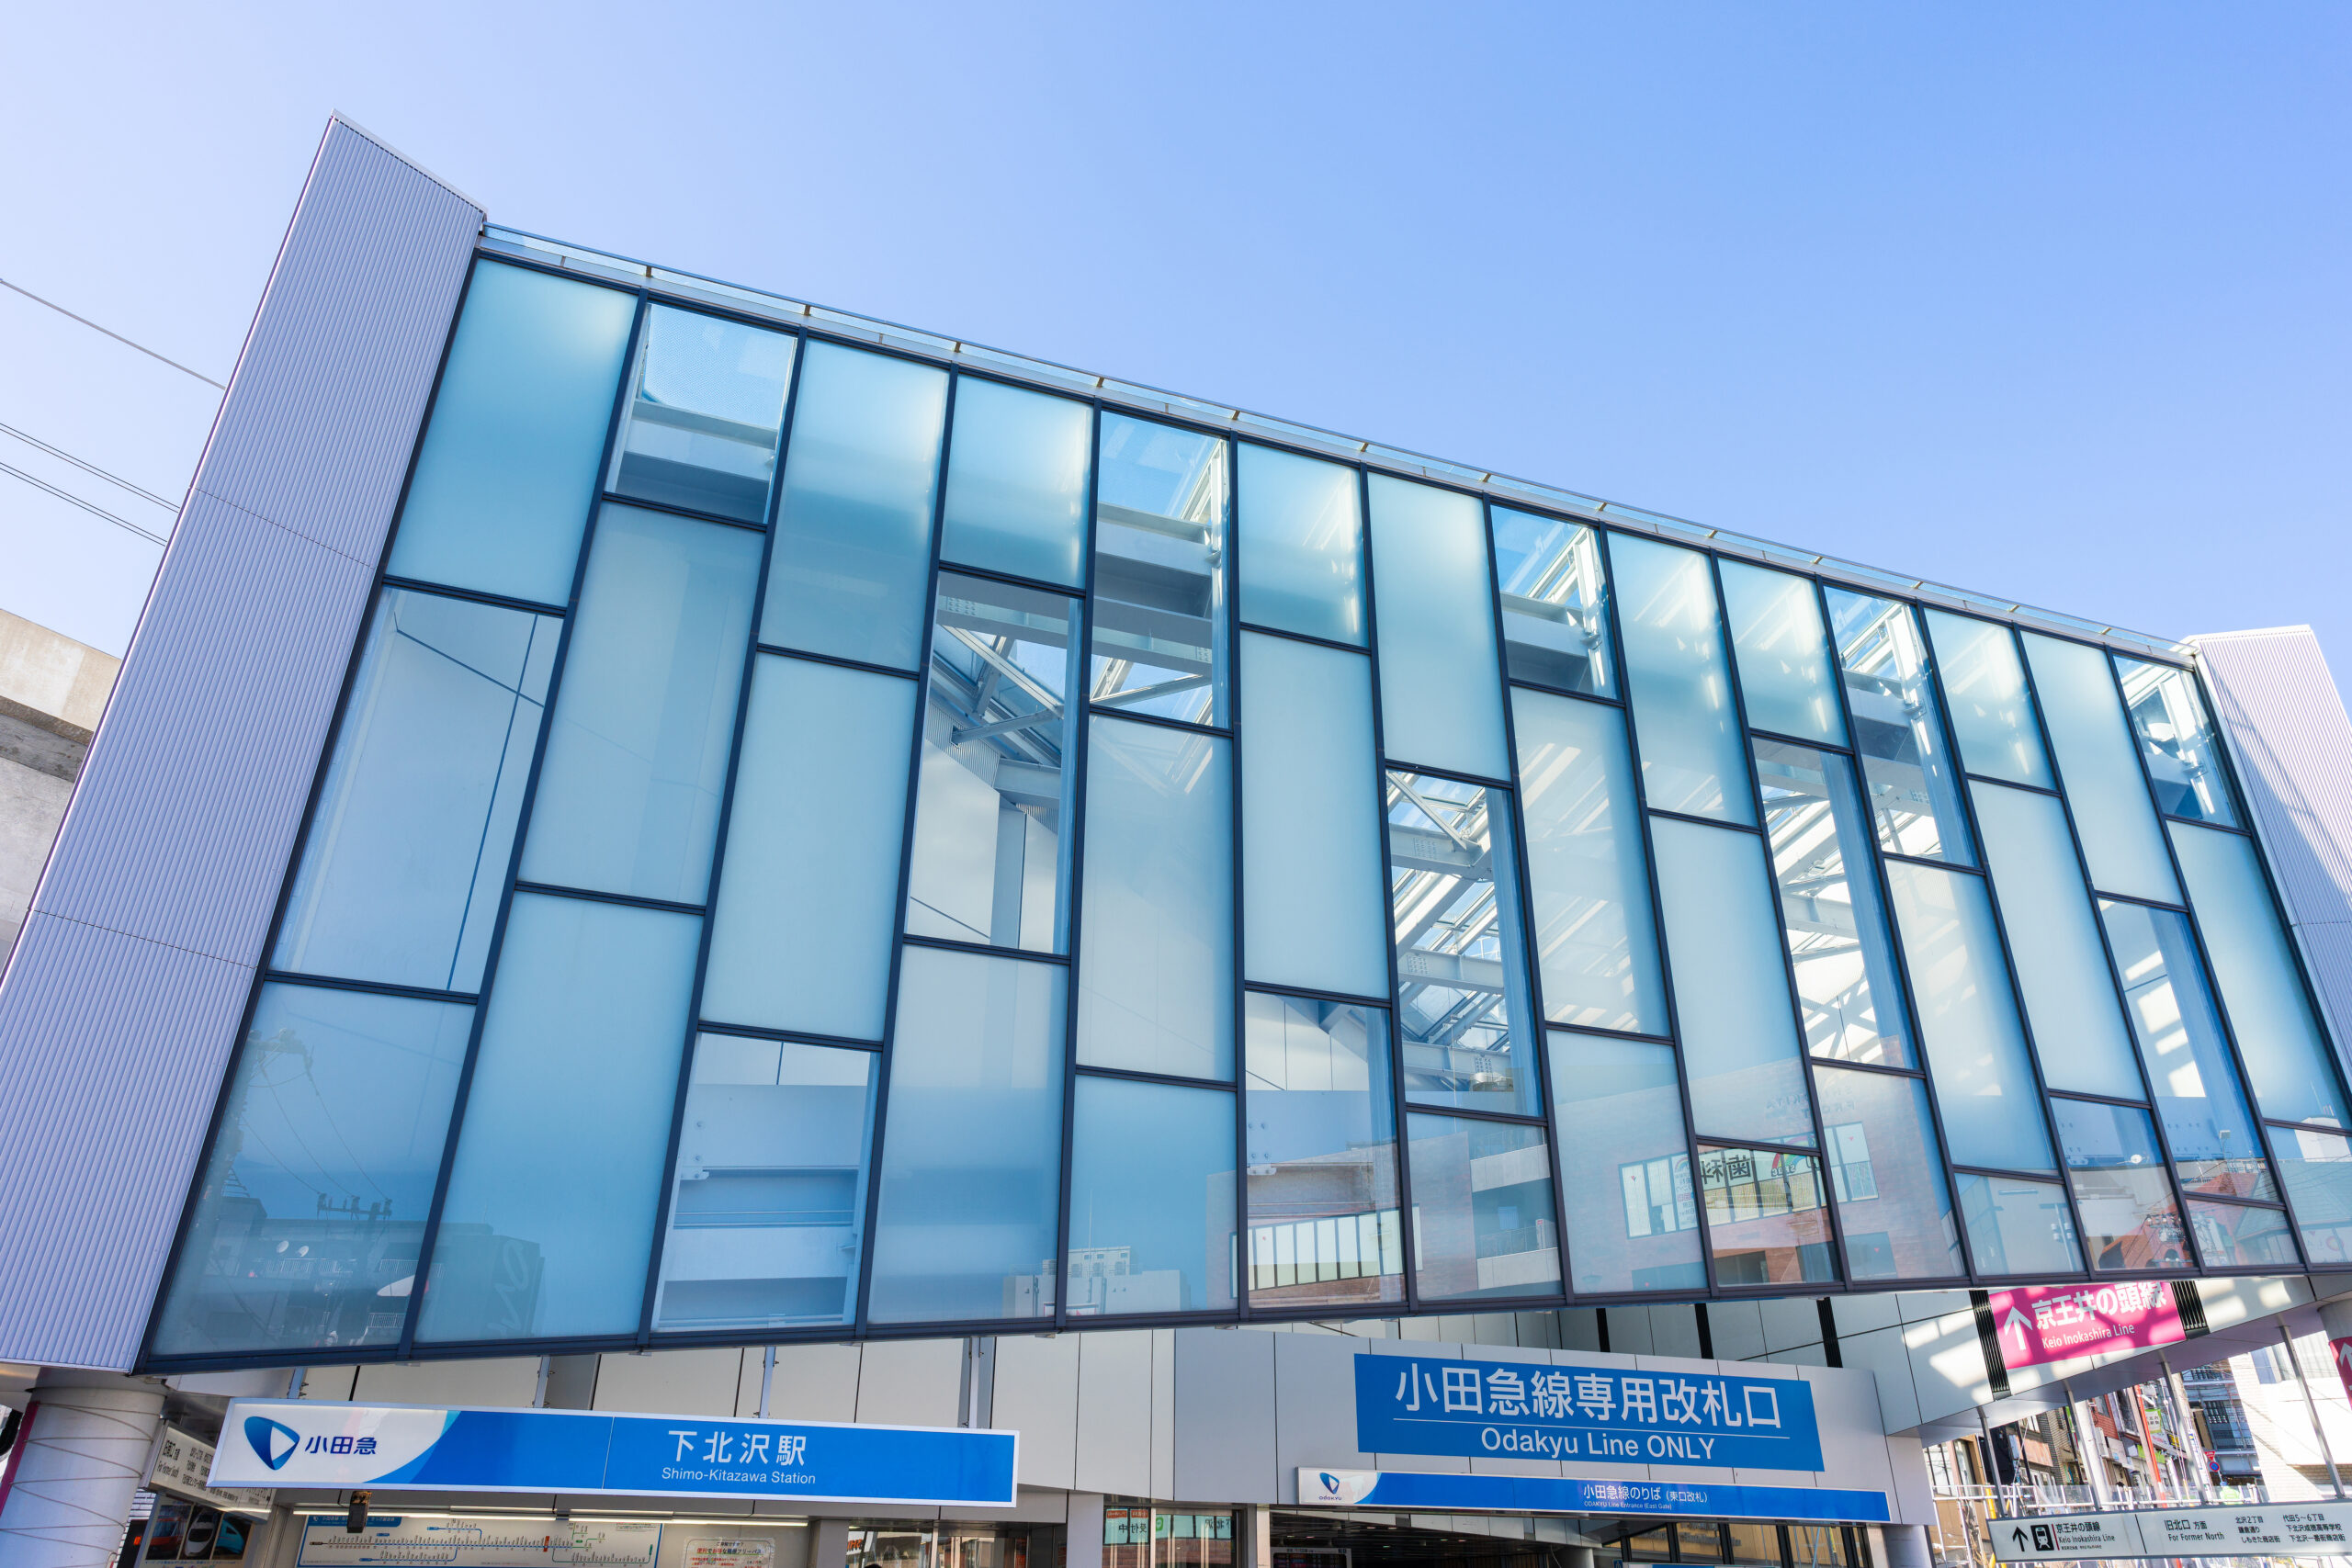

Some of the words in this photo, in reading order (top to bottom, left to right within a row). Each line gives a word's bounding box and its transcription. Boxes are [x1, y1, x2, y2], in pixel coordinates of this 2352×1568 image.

[2031, 1282, 2167, 1330] 京王井の頭線
[2041, 1337, 2062, 1349] Keio
[2064, 1326, 2112, 1346] Inokashira
[2113, 1324, 2135, 1337] Line
[1395, 1362, 1781, 1429] 小田急線専用改札口
[304, 1436, 378, 1455] 小田急
[668, 1430, 807, 1466] 下北沢駅
[1481, 1427, 1579, 1459] Odakyu
[1588, 1432, 1639, 1457] Line
[1647, 1435, 1715, 1460] ONLY
[662, 1467, 767, 1483] Shimo-Kitazawa
[771, 1471, 816, 1484] Station
[1583, 1483, 1661, 1501] 小田急線のりば
[2055, 1521, 2102, 1533] 京王井の頭線
[2164, 1519, 2191, 1531] 旧北口
[2193, 1520, 2208, 1530] 方面
[2072, 1535, 2102, 1543] Inokashira
[2168, 1533, 2179, 1542] For
[2180, 1532, 2203, 1541] Former
[2205, 1531, 2225, 1540] North
